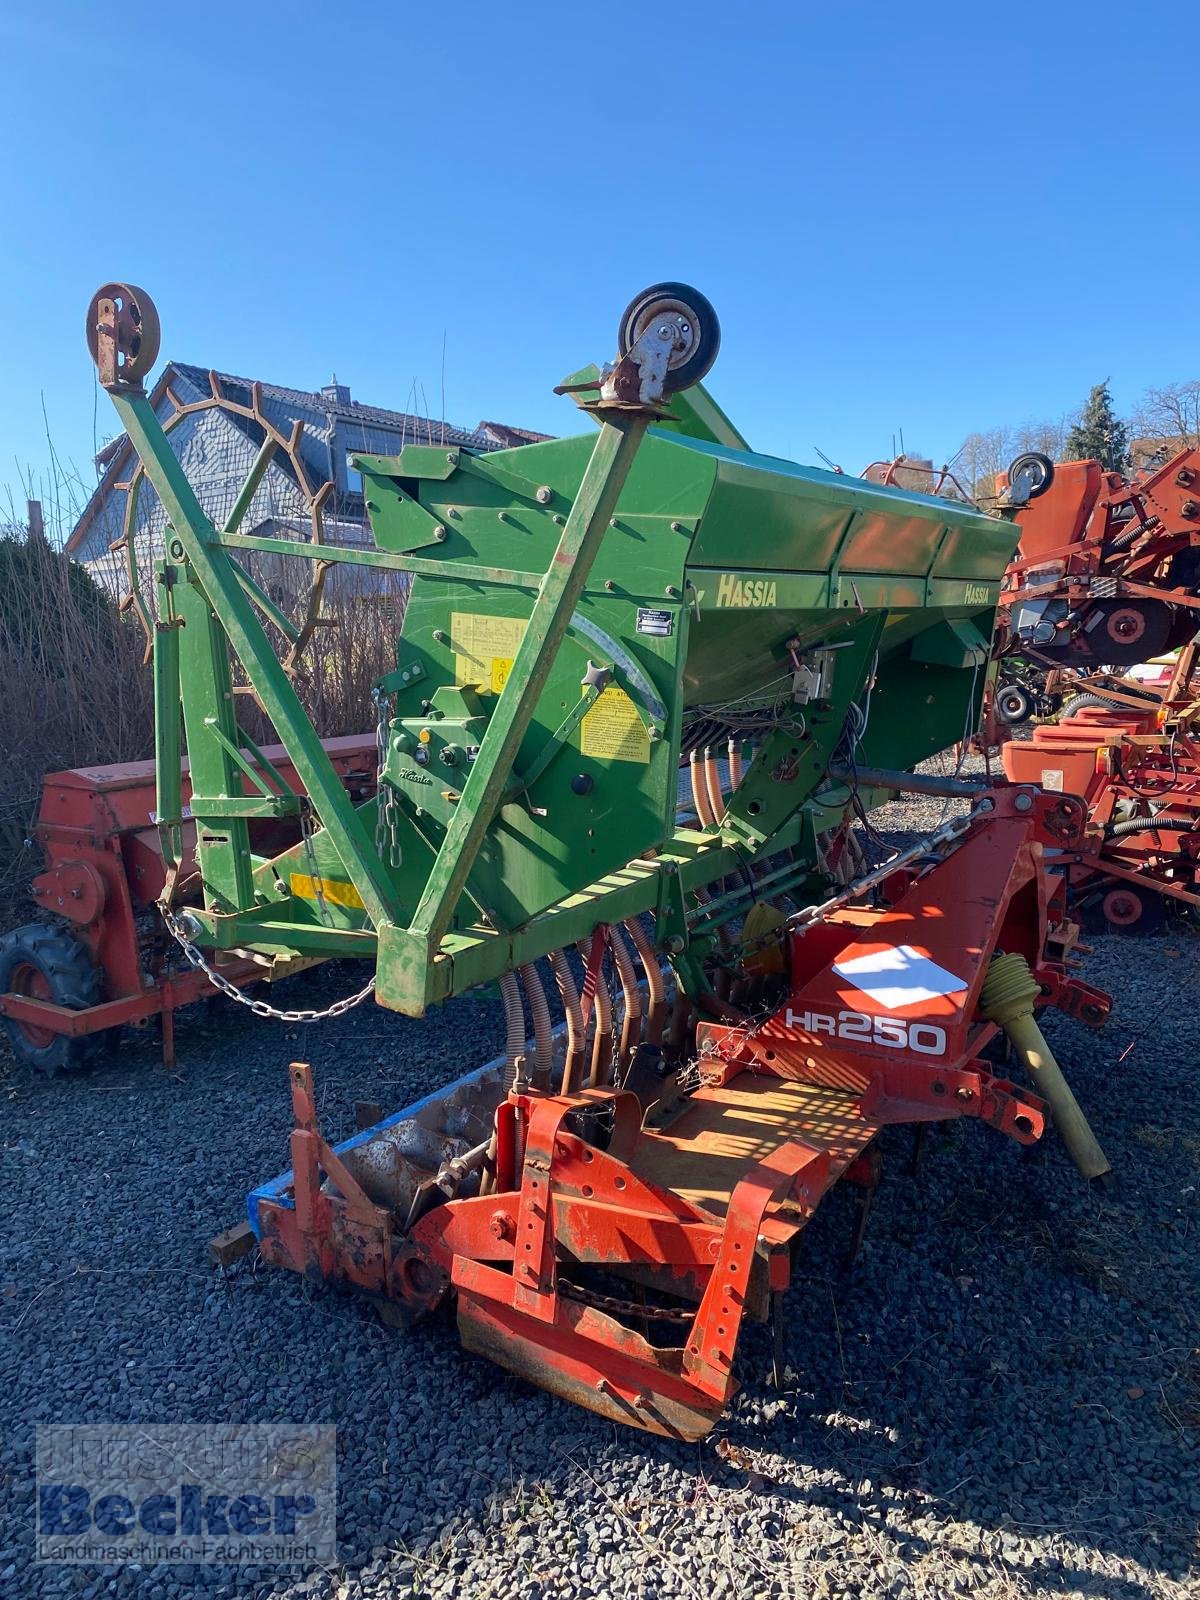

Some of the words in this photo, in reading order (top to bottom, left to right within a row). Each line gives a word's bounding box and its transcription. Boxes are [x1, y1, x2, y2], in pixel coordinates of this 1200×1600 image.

[715, 574, 777, 607] HASSIA
[964, 583, 990, 606] HASSIA
[399, 767, 430, 784] Hassia
[785, 1008, 946, 1056] HR250
